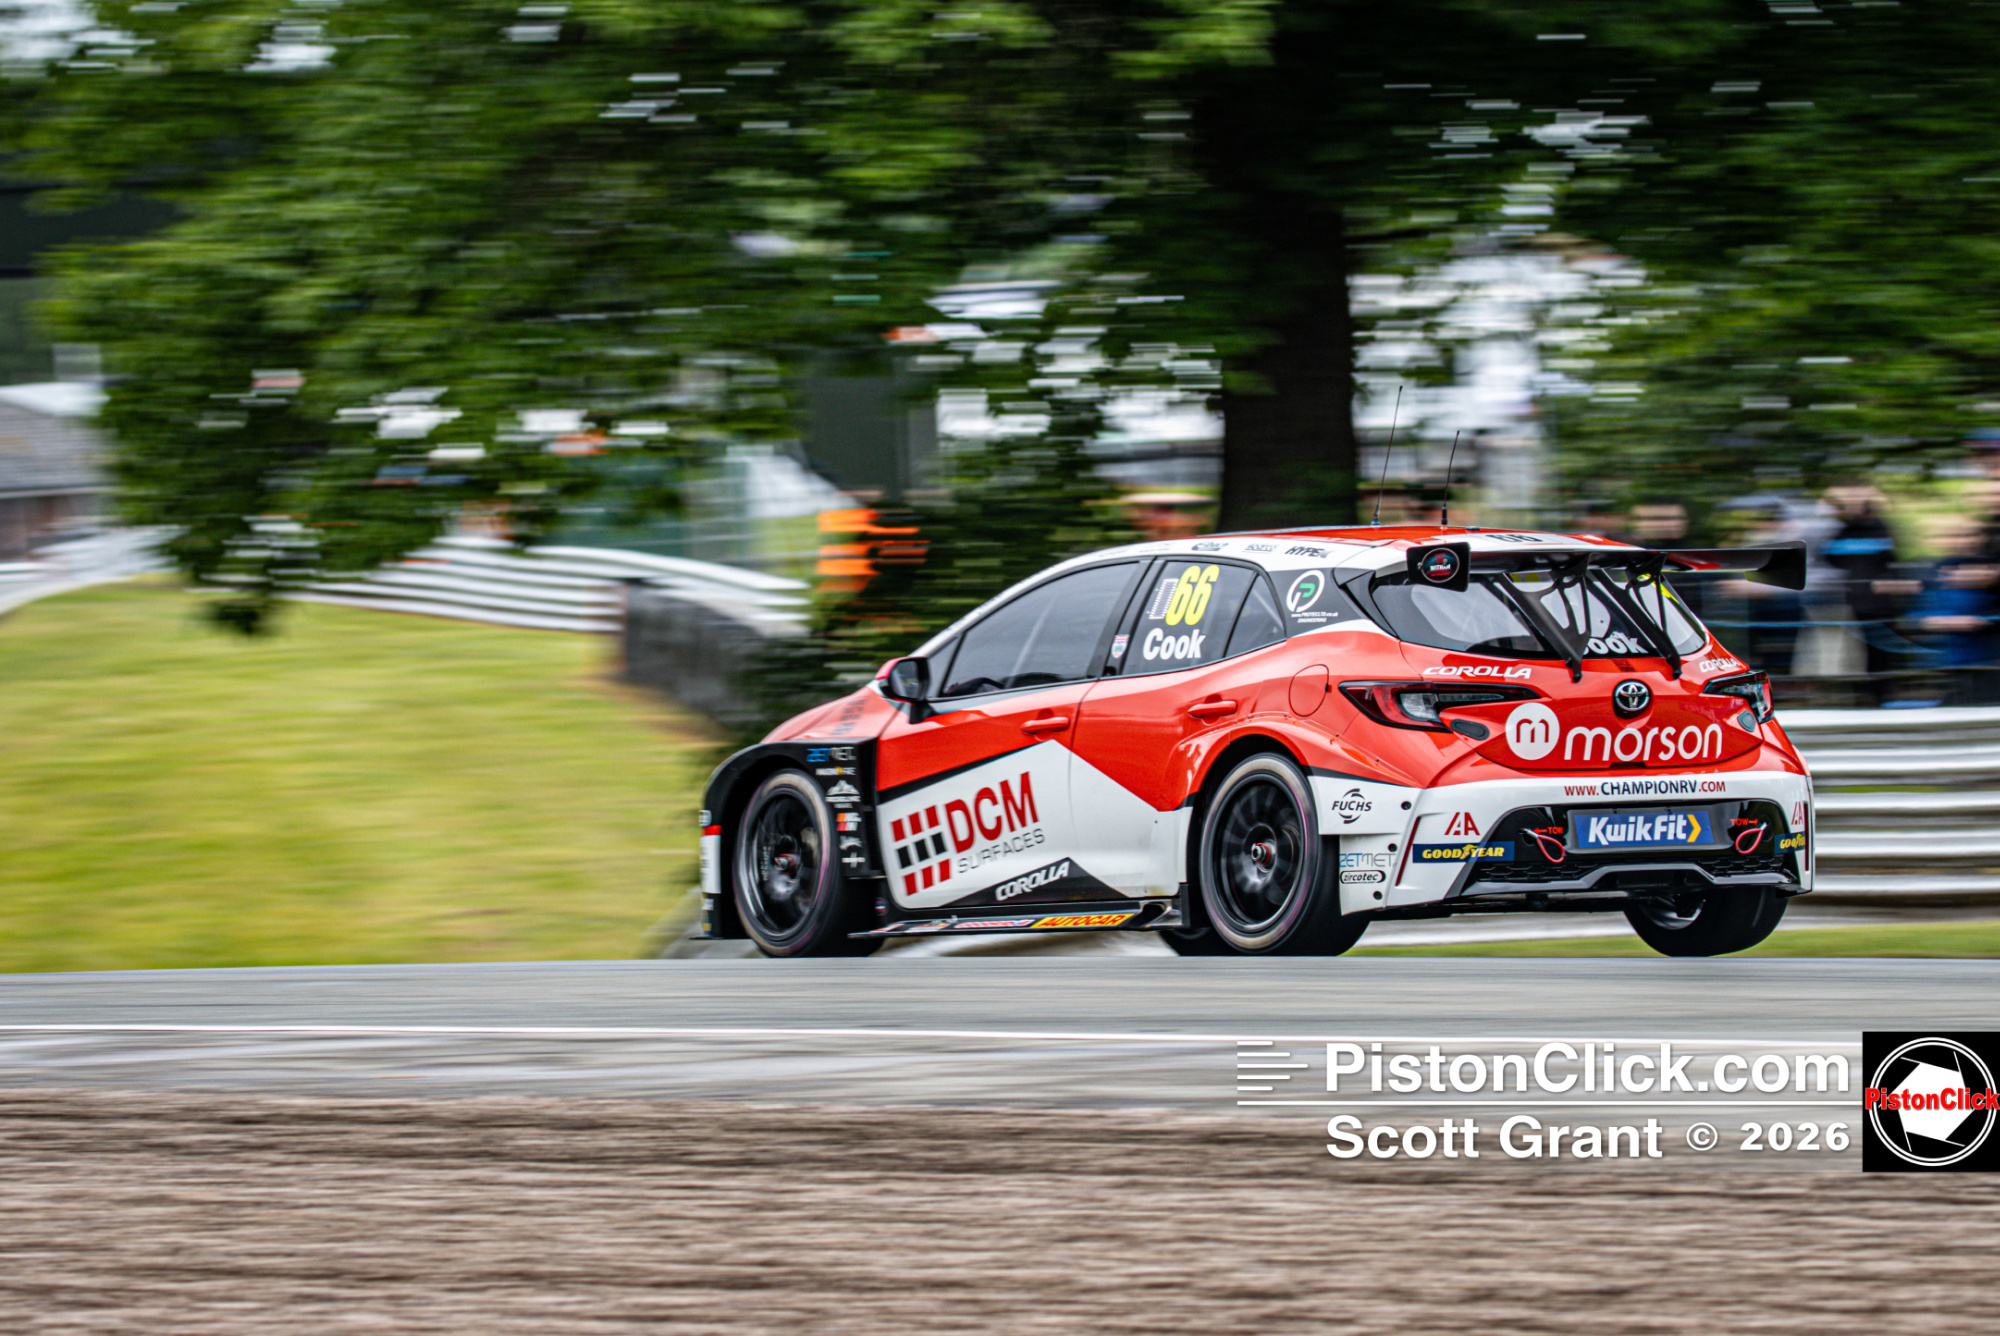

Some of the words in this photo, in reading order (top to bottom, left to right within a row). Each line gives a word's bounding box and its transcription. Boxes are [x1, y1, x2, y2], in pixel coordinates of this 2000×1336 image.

[1165, 565, 1220, 626] 66
[1143, 628, 1206, 660] Cook
[1422, 666, 1532, 679] COROLLA
[1699, 657, 1741, 673] COROLLA
[1564, 723, 1723, 761] morson
[944, 771, 1040, 854] DCM
[1331, 800, 1373, 812] FUCHS
[1548, 826, 1564, 835] TOW
[1730, 818, 1749, 827] TOW
[957, 828, 1045, 874] SURFACES
[995, 861, 1070, 901] COROLLA
[1344, 872, 1379, 882] zircotec
[1042, 913, 1127, 927] AUTOCAR
